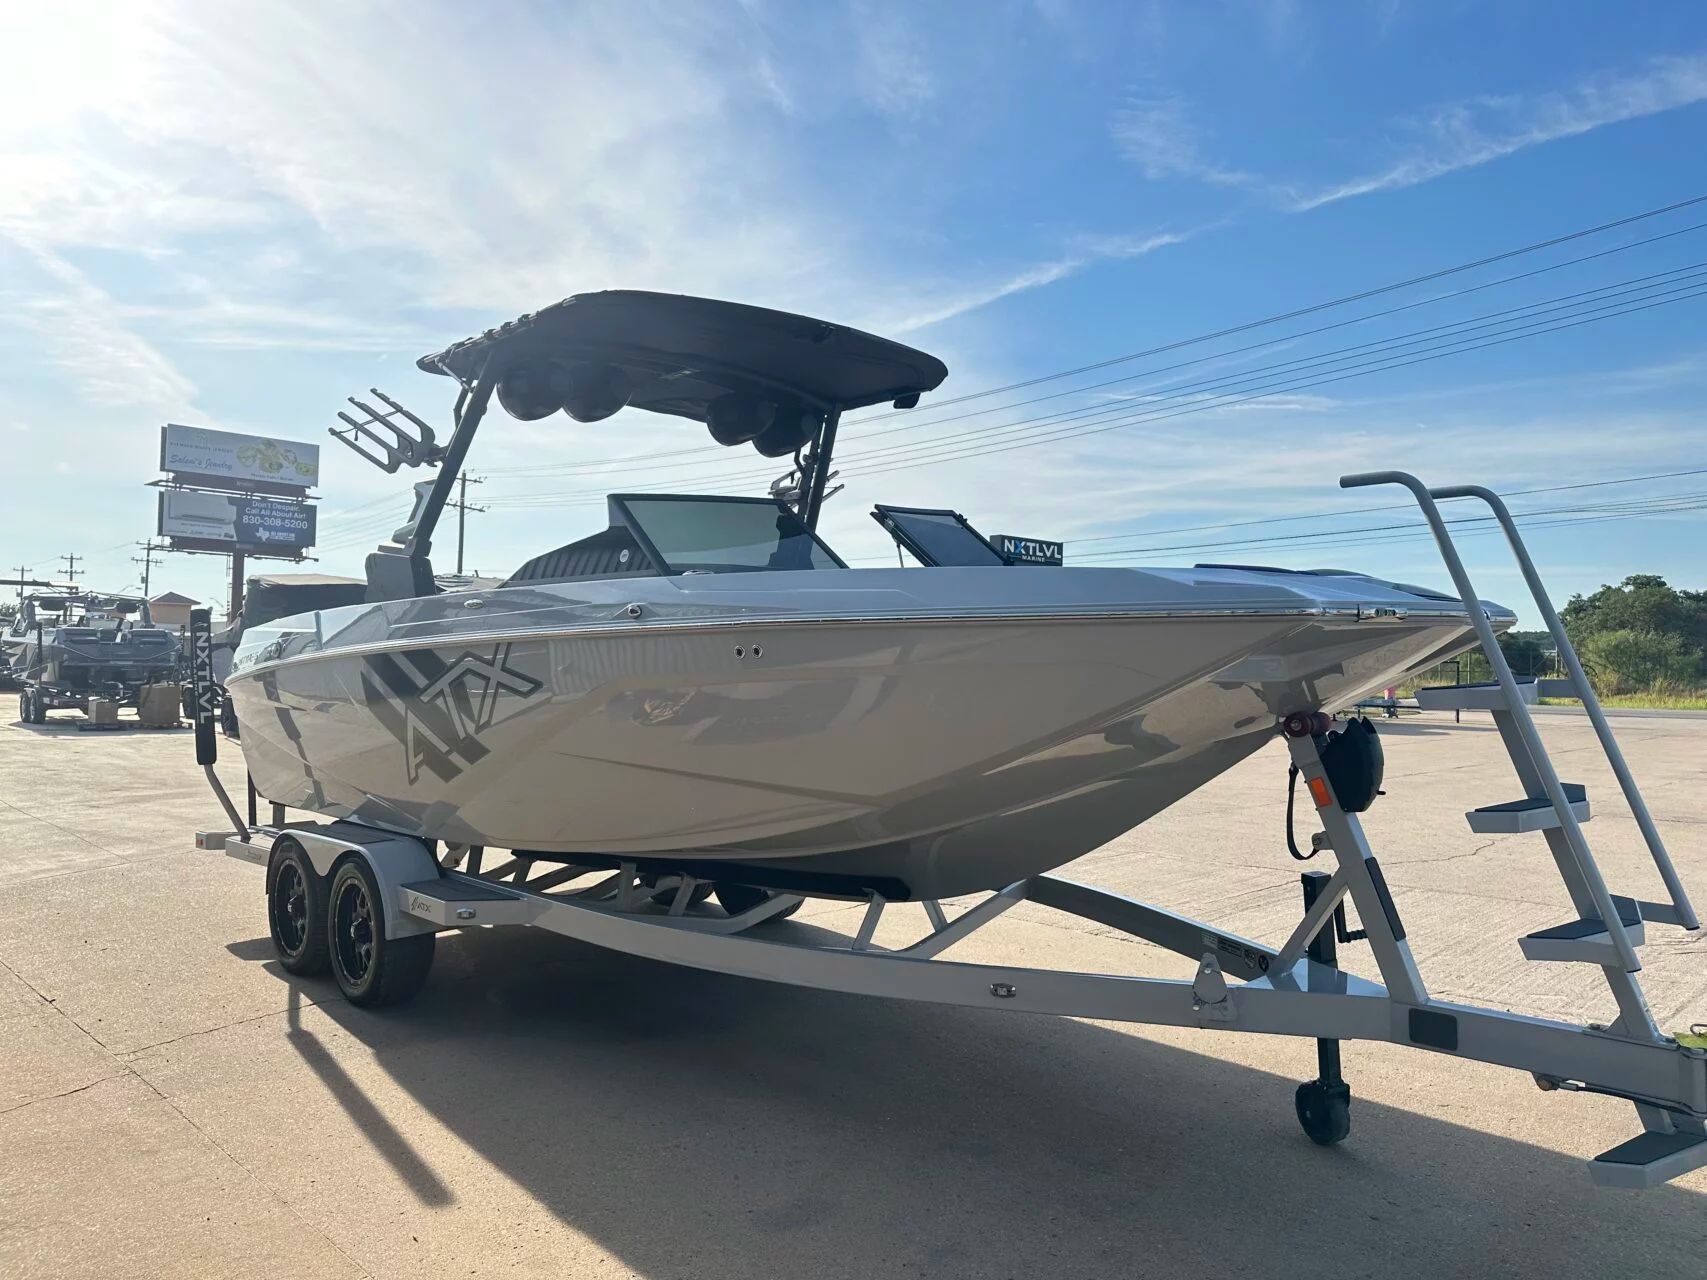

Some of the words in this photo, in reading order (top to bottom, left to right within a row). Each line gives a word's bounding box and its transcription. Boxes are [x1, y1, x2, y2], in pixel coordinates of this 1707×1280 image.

[242, 515, 308, 529] 830-308-5200
[271, 510, 292, 518] About
[1004, 539, 1061, 558] NXTLVL
[196, 632, 212, 724] NXTLVL
[405, 642, 544, 786] ATX
[416, 902, 432, 913] ATX
